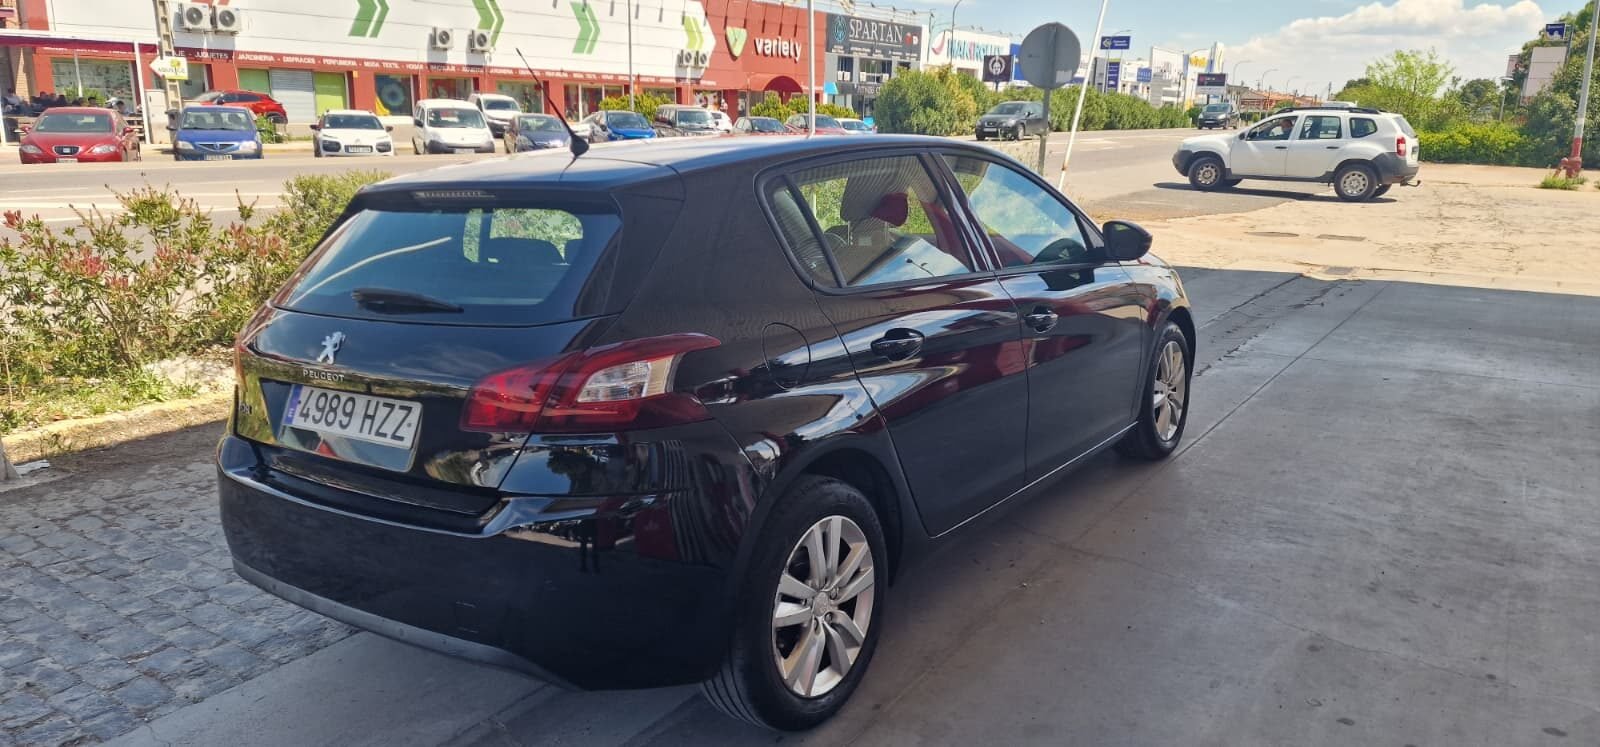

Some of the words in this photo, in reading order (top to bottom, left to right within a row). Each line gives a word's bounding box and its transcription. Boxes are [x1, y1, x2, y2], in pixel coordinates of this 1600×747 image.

[849, 18, 904, 43] SPARTAN
[754, 36, 802, 63] variety
[303, 369, 345, 381] PEUGEOT
[299, 389, 356, 430] 4989
[359, 399, 413, 442] HZZ
